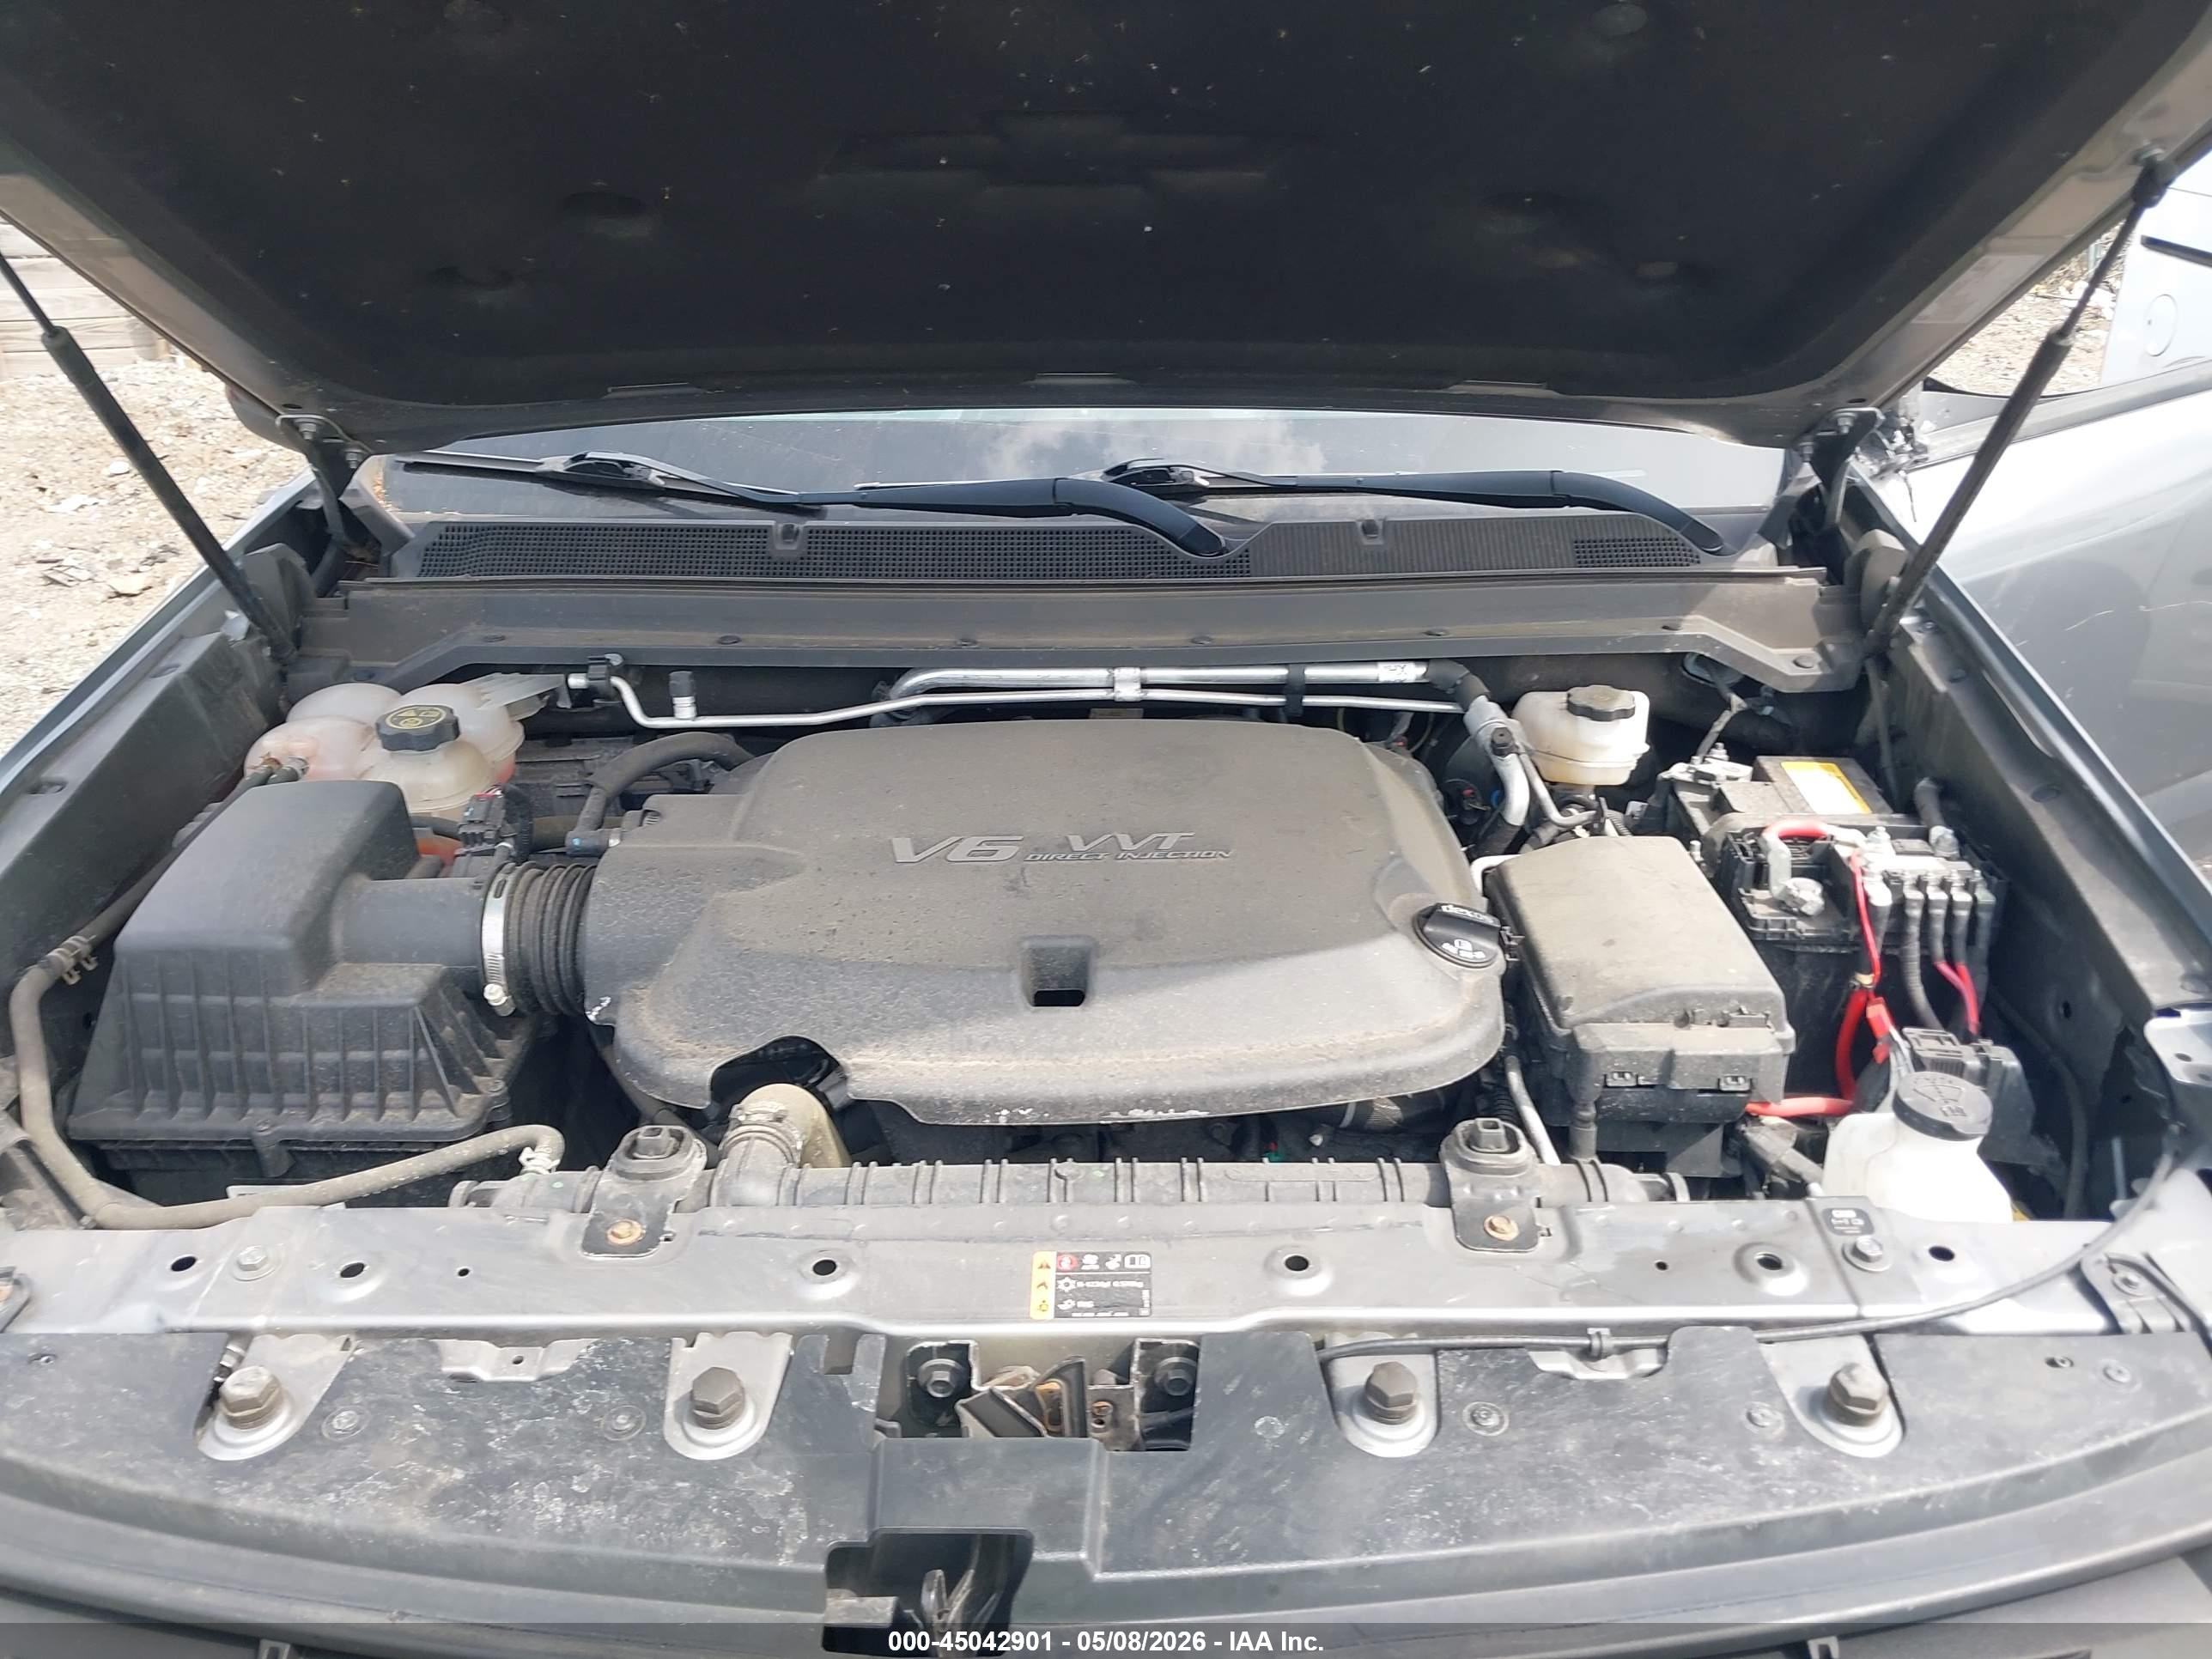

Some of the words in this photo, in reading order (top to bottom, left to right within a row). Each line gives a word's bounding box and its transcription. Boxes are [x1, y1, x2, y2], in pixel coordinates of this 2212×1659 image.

[891, 836, 1024, 863] V6
[1066, 831, 1195, 851] VVT
[1024, 852, 1110, 861] DIRECT
[1116, 850, 1233, 860] INJECTION
